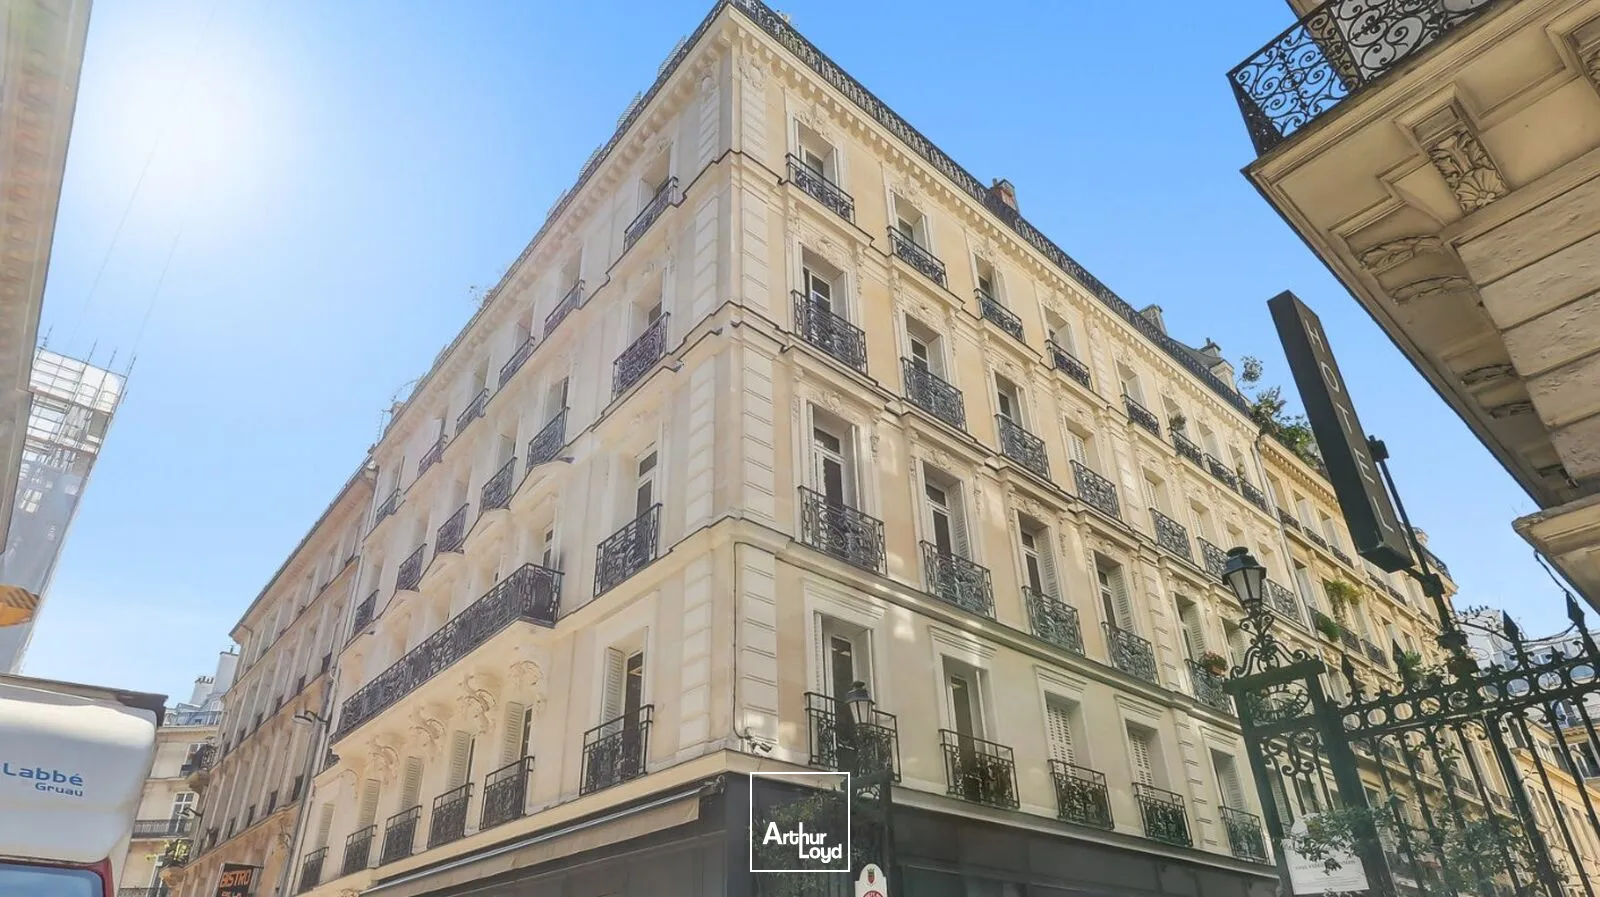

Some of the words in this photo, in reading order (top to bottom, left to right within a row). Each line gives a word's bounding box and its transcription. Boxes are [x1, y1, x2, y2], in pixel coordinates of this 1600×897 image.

[1305, 319, 1394, 533] HOTEL
[3, 763, 83, 787] Labbé
[35, 782, 83, 797] Gruau
